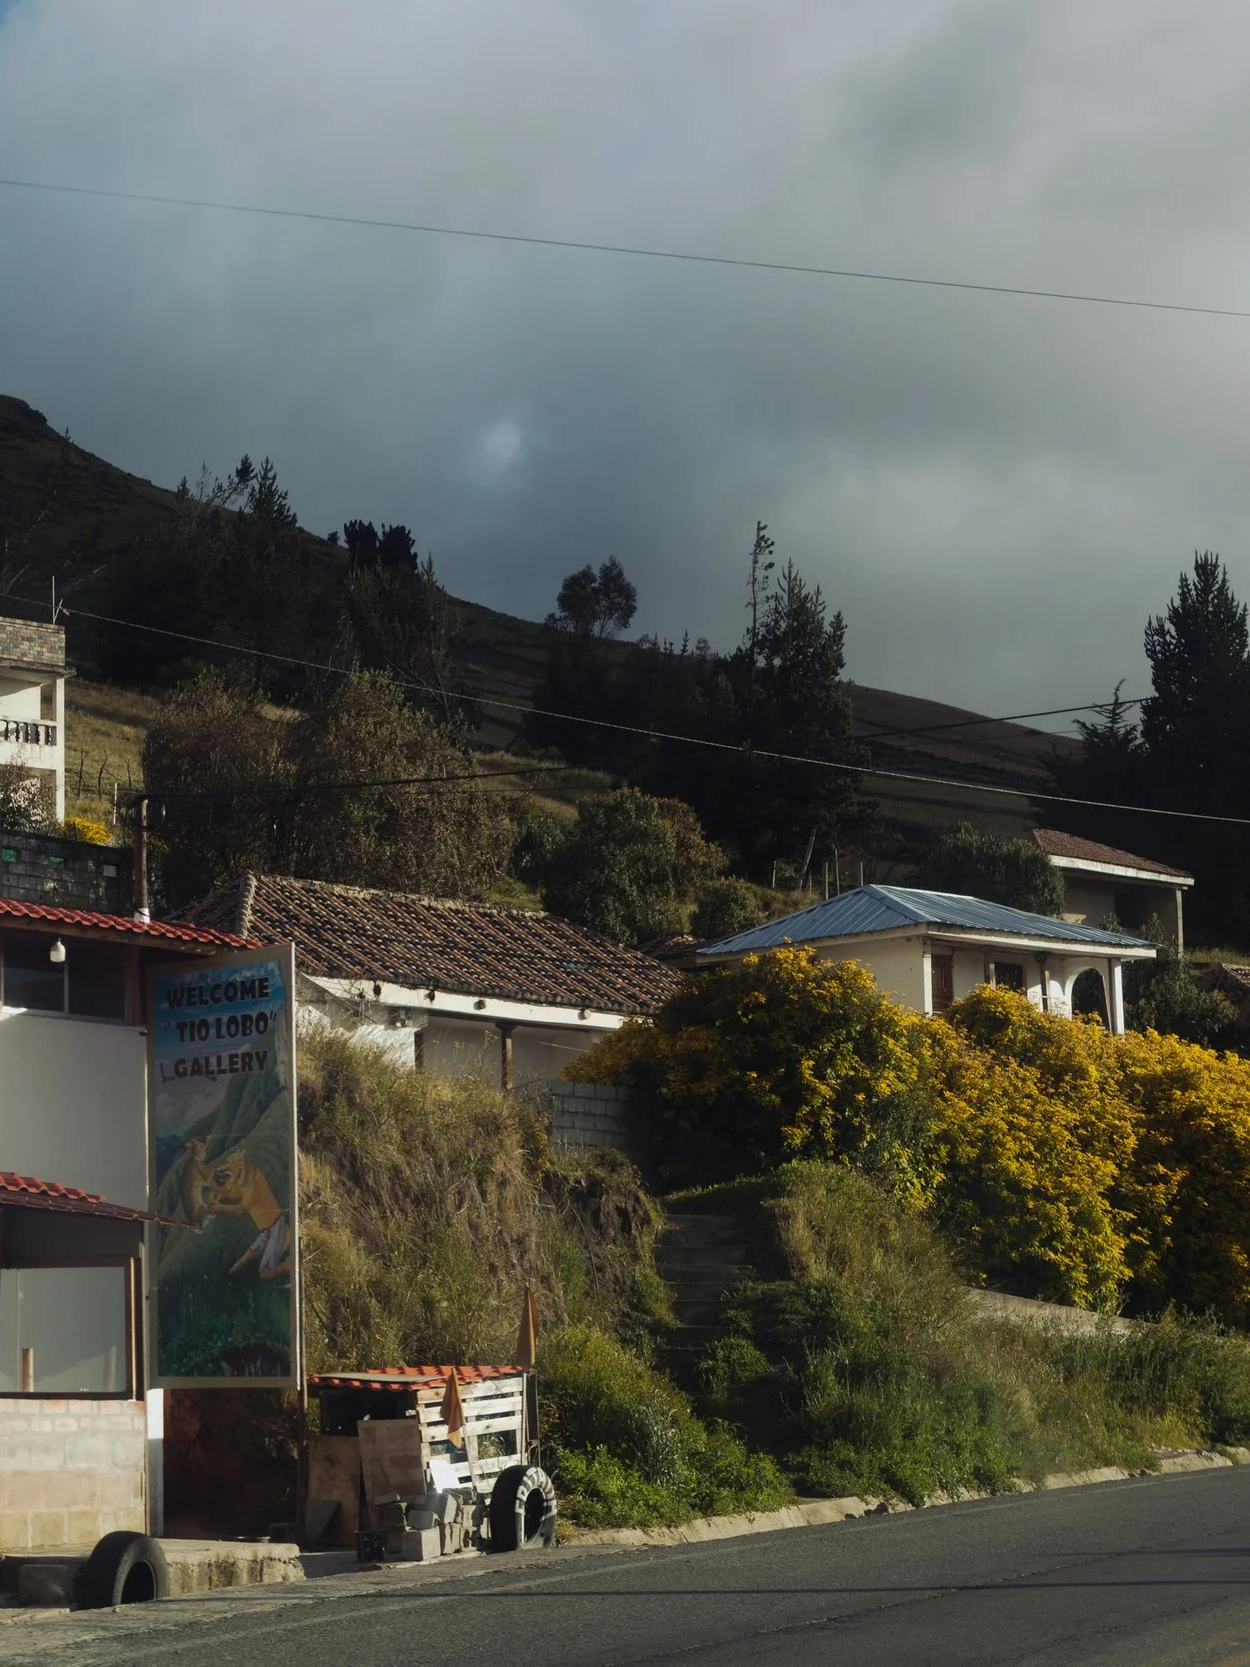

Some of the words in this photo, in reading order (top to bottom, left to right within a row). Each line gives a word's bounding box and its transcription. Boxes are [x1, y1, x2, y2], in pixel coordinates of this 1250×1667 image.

[165, 977, 270, 1009] WELCOME
[214, 1010, 277, 1039] LOBO"
[173, 1050, 269, 1079] GALLERY
